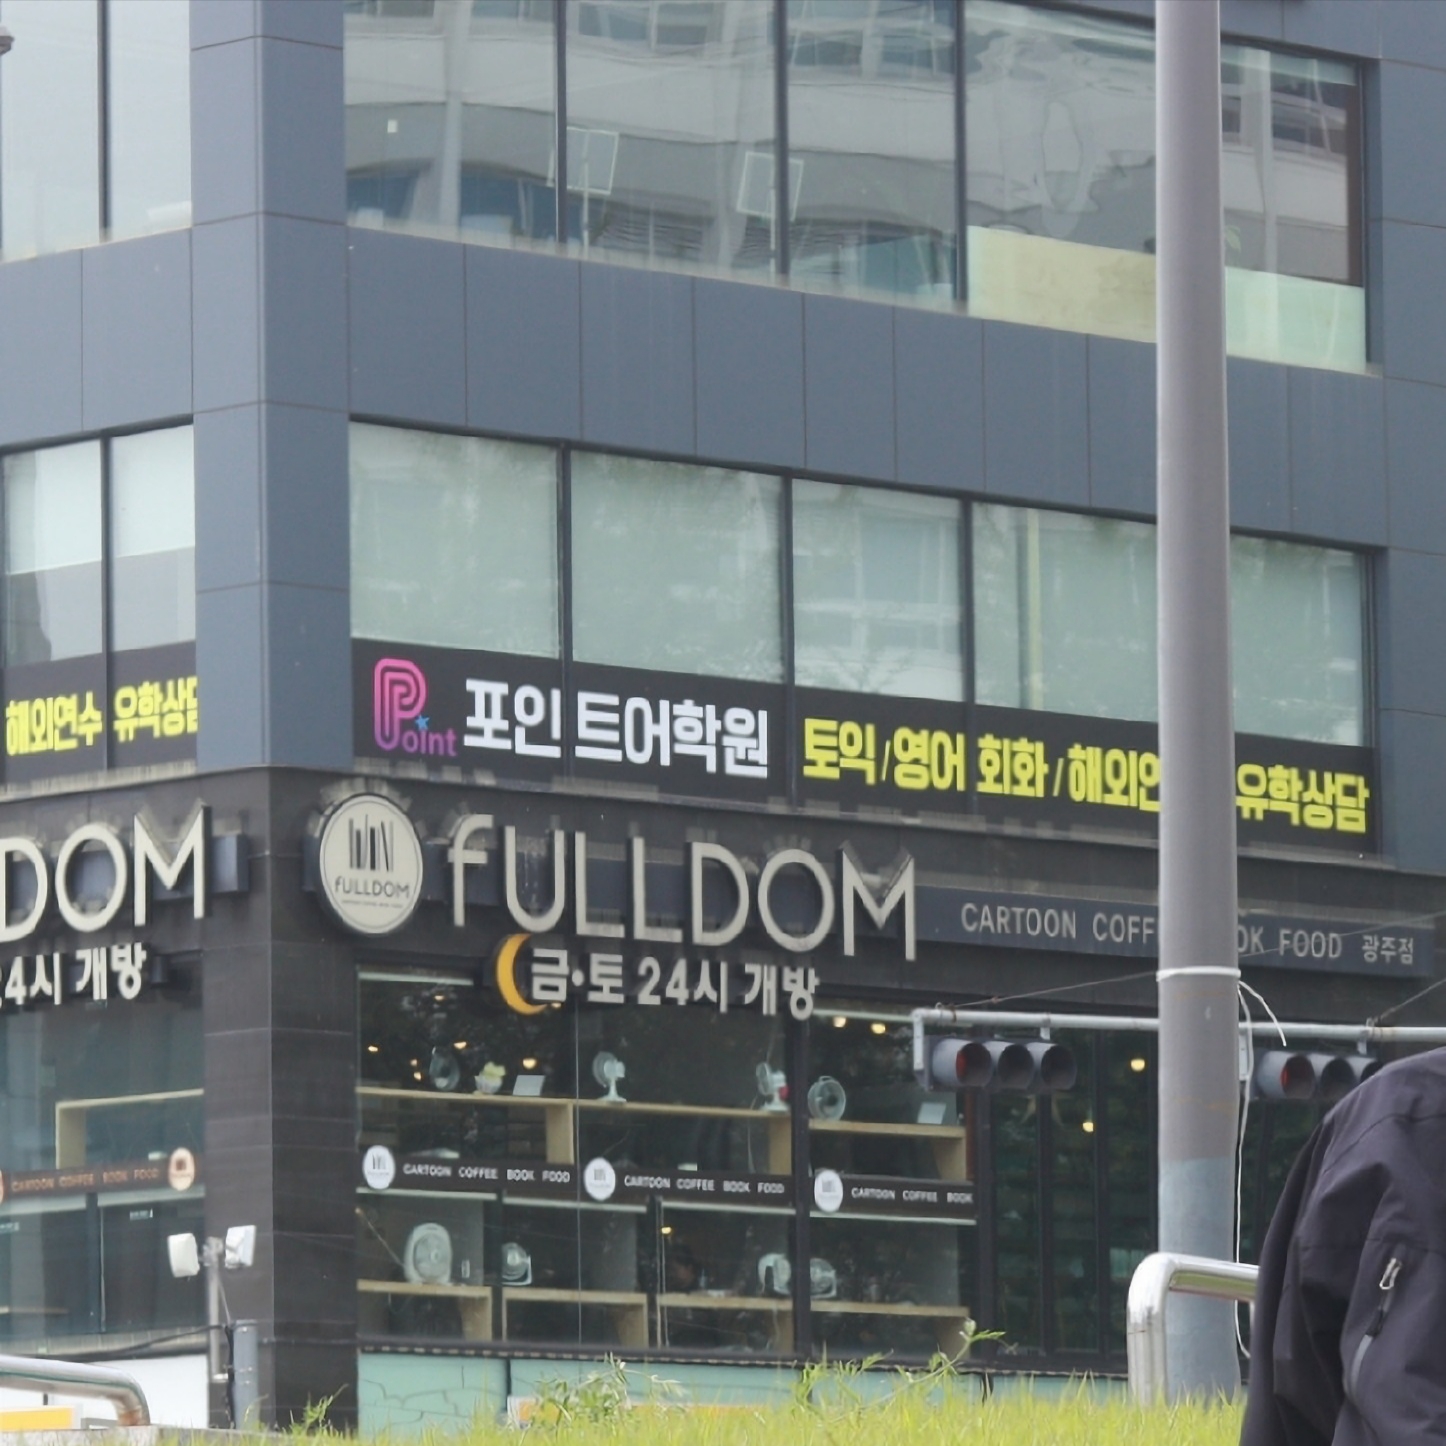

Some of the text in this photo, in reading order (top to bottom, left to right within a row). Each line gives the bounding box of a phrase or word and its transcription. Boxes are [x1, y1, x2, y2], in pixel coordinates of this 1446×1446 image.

[6, 691, 103, 756] 해외연수
[1235, 763, 1370, 833] 유학상담
[961, 902, 1077, 939] CARTOON
[1092, 912, 1158, 944] COFF
[1279, 928, 1342, 958] FOOD
[1361, 934, 1414, 965] 광주점
[0, 943, 147, 1005] 4시 개방
[638, 956, 728, 1013] 24시
[744, 963, 820, 1020] 개방
[403, 1163, 452, 1177] CARTOON
[458, 1166, 498, 1180] COFFEE
[507, 1169, 535, 1182] BOOK
[542, 1170, 571, 1184] FOOD
[624, 1175, 671, 1189] CARTOON
[676, 1178, 715, 1192] COFFEE
[723, 1180, 750, 1193] BOOK
[757, 1182, 785, 1195] FOOD
[851, 1187, 896, 1200] CARTOON
[902, 1190, 938, 1203] COFFEE
[947, 1192, 974, 1204] BOOK
